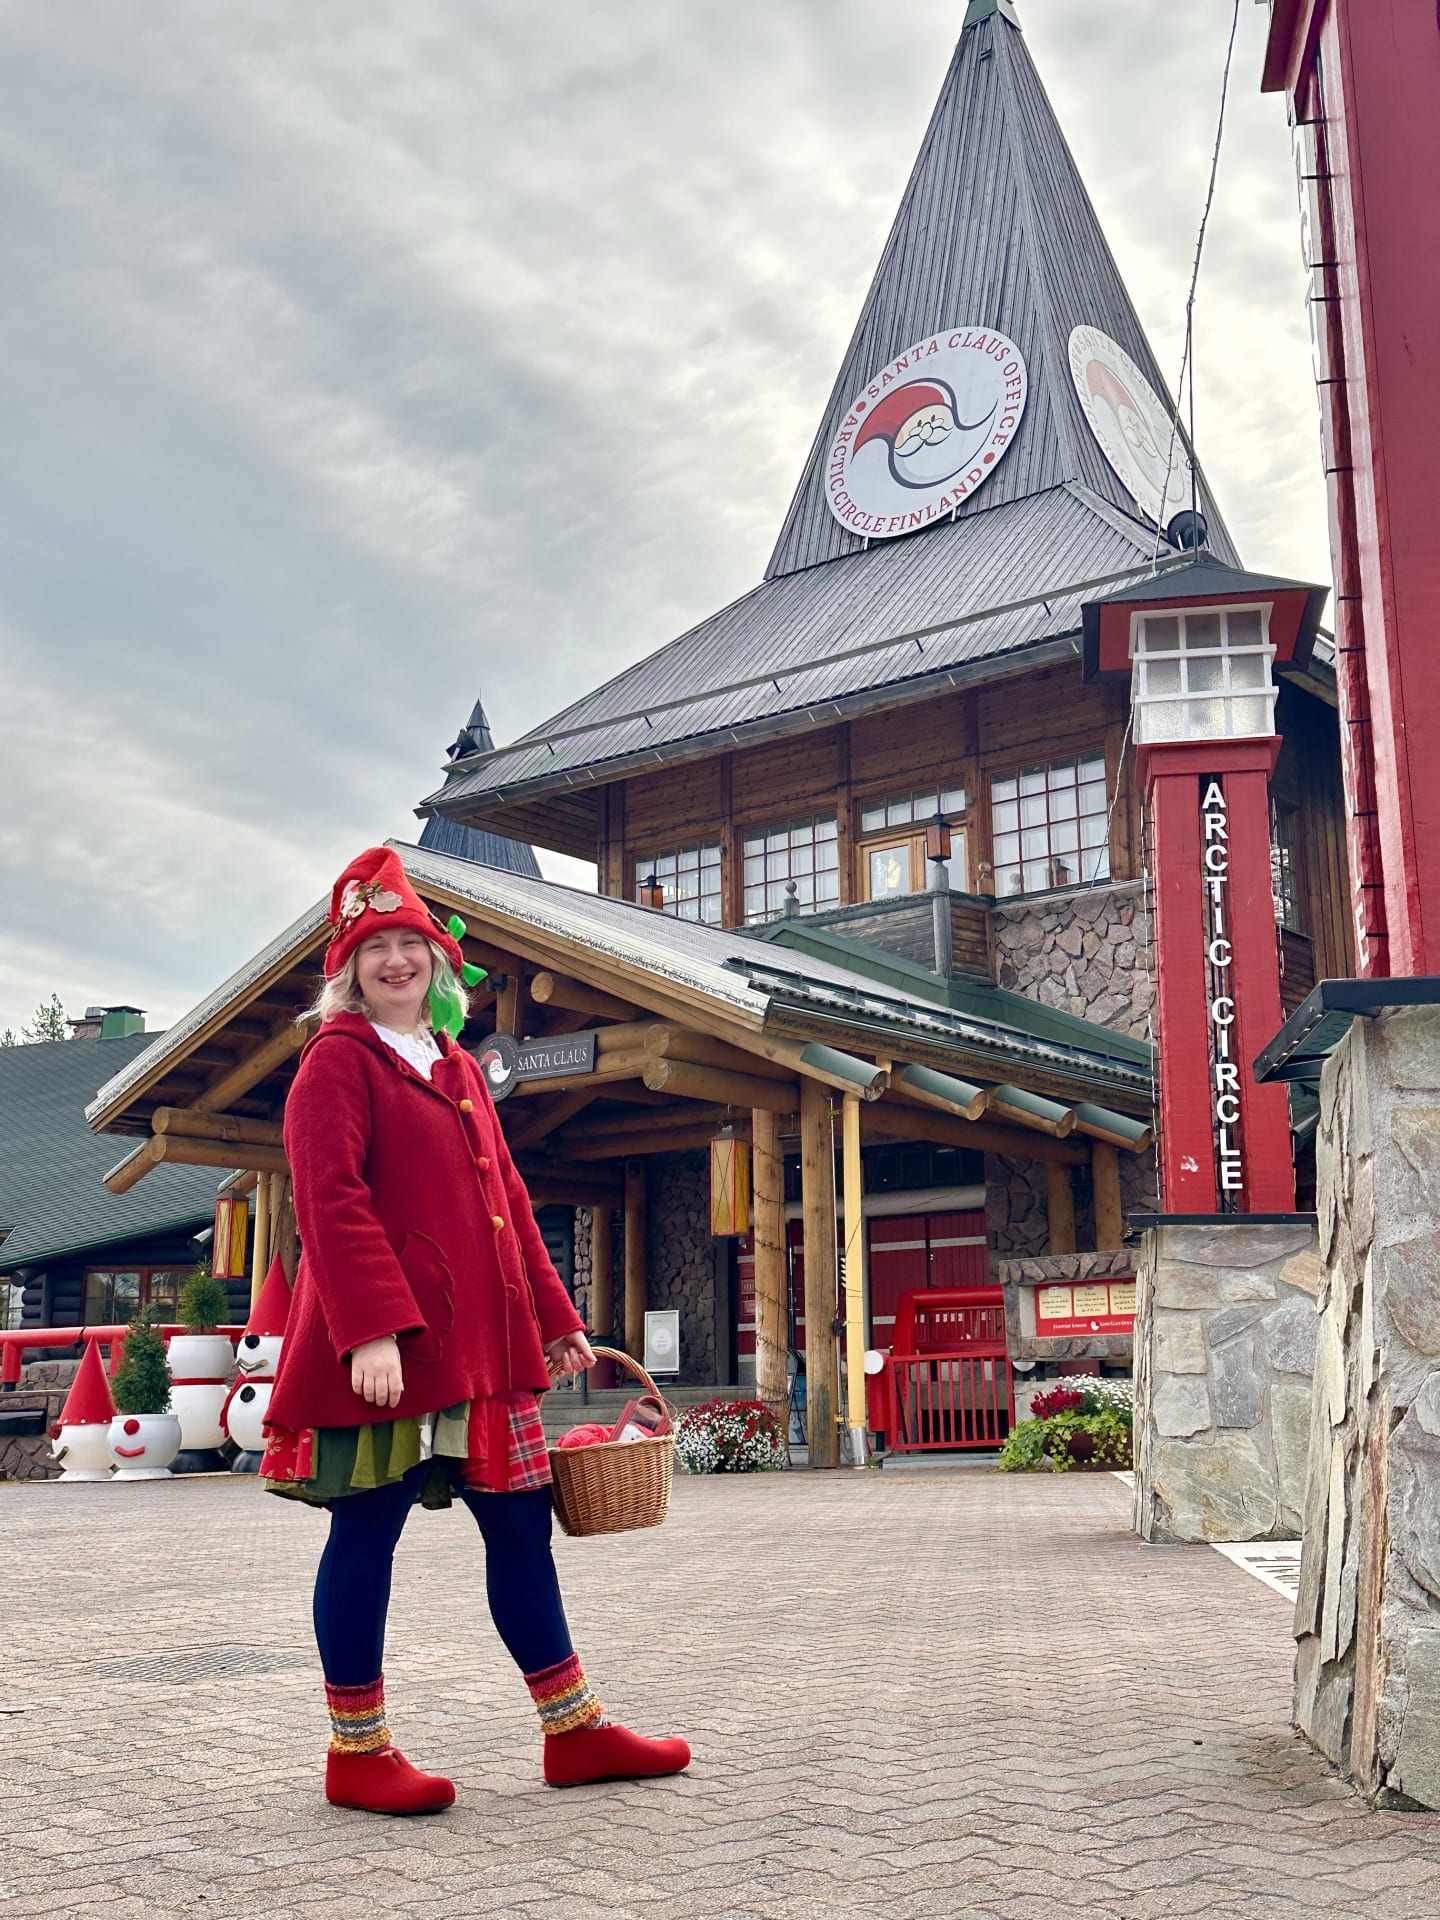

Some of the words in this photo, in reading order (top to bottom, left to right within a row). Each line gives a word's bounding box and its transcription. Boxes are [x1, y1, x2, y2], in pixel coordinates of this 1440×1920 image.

[867, 339, 939, 399] SANTA
[947, 332, 1011, 362] CLAUS
[991, 361, 1022, 446] OFFICE
[829, 415, 858, 492] ARCTIC
[833, 491, 886, 533] CIRCLE
[887, 467, 983, 533] FINLAND
[1202, 782, 1232, 968] ARCTIC
[517, 1052, 550, 1071] SANTA
[553, 1047, 588, 1066] CLAUS
[1211, 996, 1243, 1190] CIRCLE
